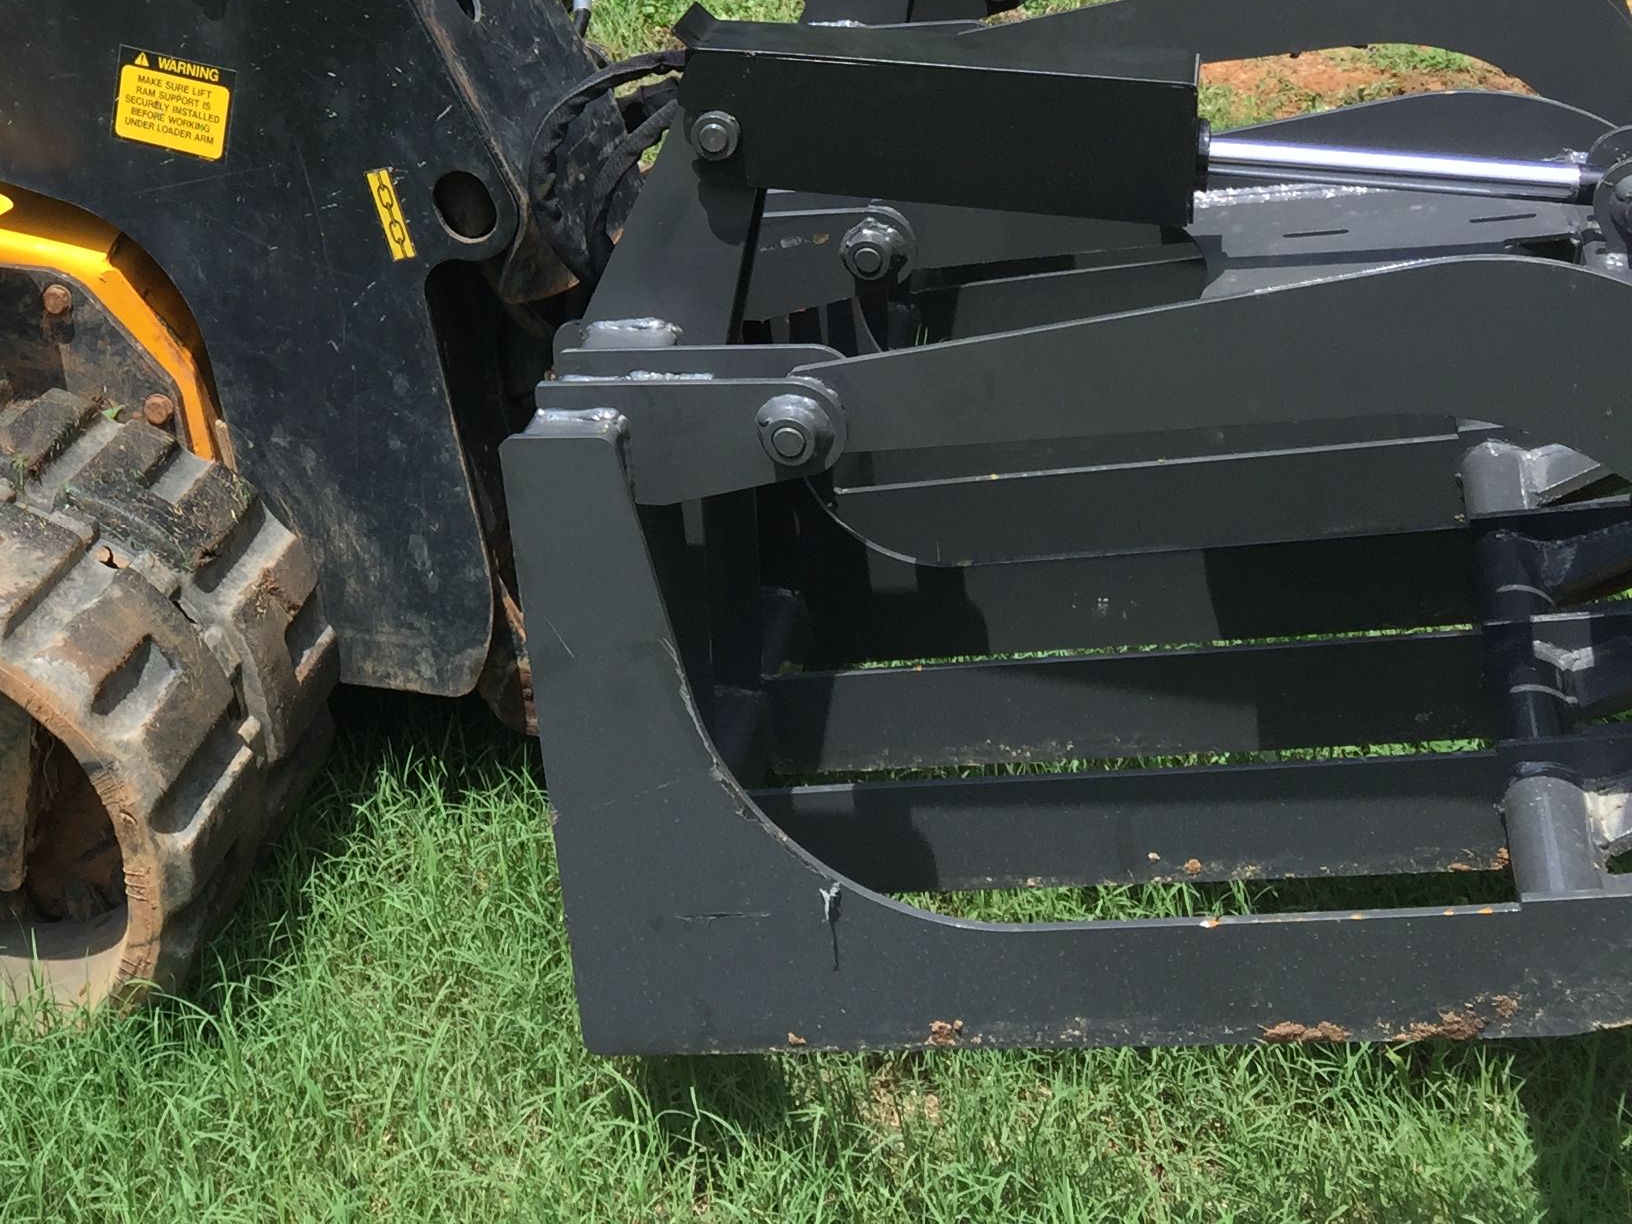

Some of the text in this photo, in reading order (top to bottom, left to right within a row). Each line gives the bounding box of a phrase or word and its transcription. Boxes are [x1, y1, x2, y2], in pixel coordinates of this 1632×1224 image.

[158, 57, 220, 82] WARNING
[136, 86, 211, 111] RAM SUPPORT IS
[138, 74, 212, 99] MAKE SURE LIFT
[125, 95, 220, 124] SECURELY INSTALLED
[131, 107, 210, 133] BEFORE WORKING
[125, 117, 214, 145] UNDER LOADER ARM
